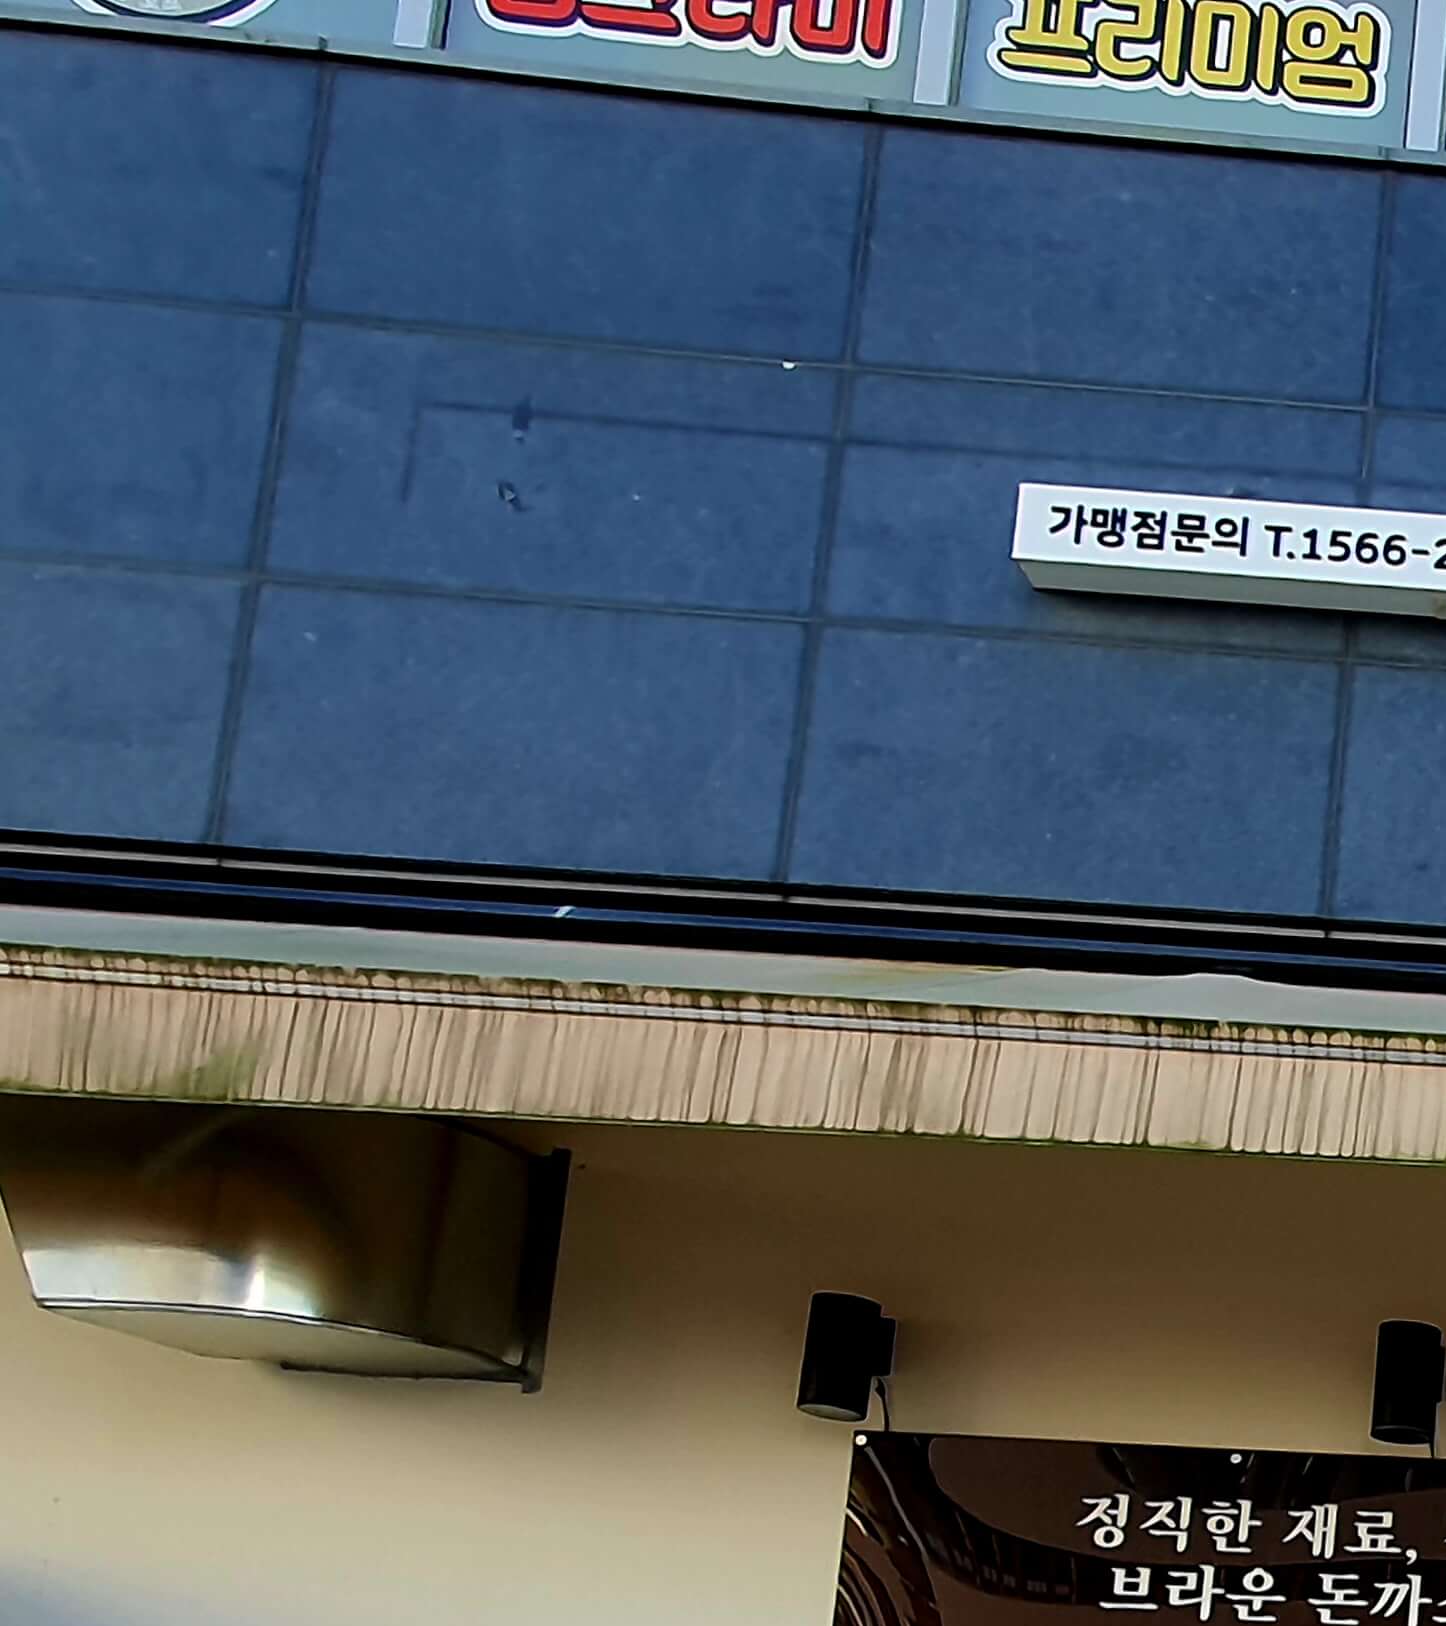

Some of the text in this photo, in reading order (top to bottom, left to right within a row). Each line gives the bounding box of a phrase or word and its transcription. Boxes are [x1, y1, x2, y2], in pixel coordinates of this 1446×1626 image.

[996, 0, 1378, 106] 프리미엄
[1049, 504, 1249, 557] 가맹점문의
[1075, 1492, 1263, 1553] 정직한
[1282, 1503, 1418, 1565] 재료,
[1099, 1564, 1286, 1623] 브라운
